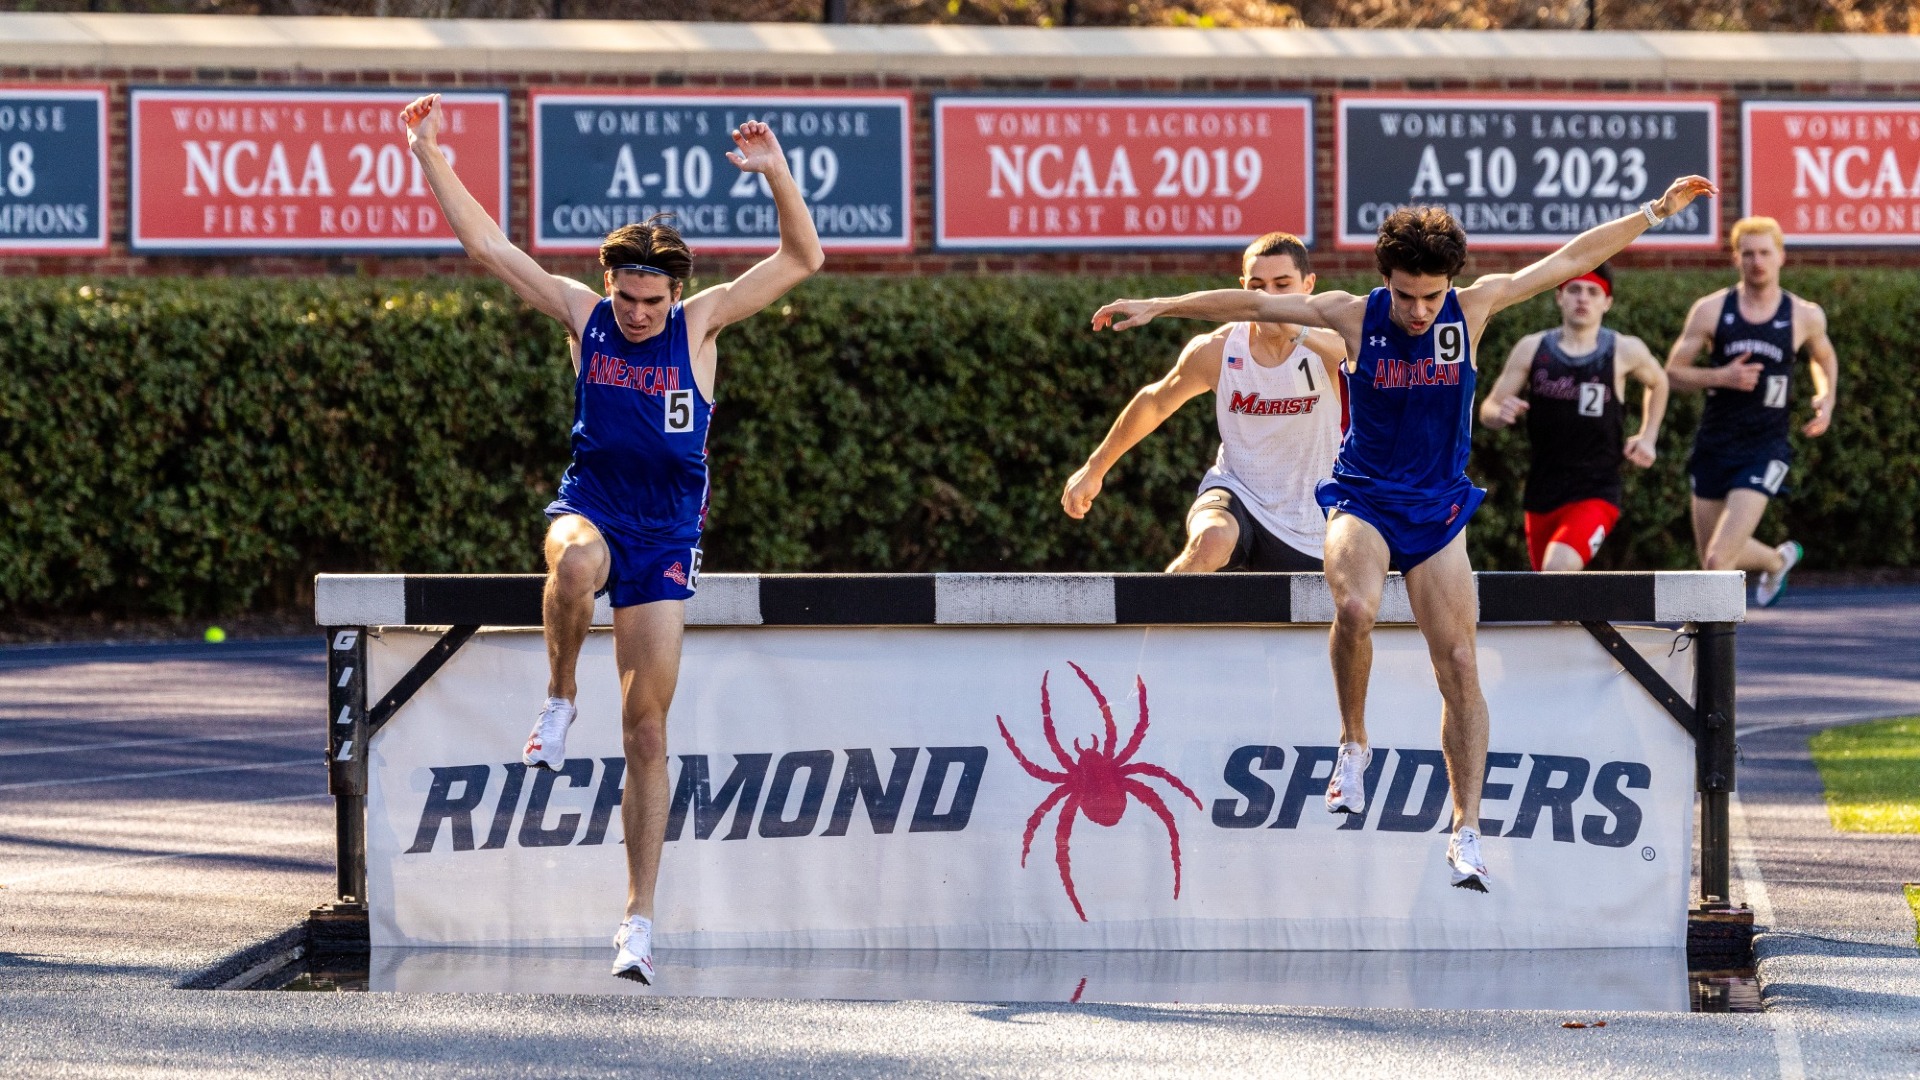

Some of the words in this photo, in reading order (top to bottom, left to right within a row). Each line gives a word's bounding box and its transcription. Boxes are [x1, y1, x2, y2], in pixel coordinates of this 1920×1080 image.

[171, 107, 307, 133] WOMEN'S
[323, 108, 467, 134] LACRE
[574, 110, 709, 136] WOMEN'S
[975, 112, 1111, 137] WOMEN'S
[1126, 112, 1272, 138] LACROSSE
[1379, 113, 1516, 138] WOMEN'S
[1532, 114, 1677, 140] LACROSSE
[1784, 115, 1920, 141] WOMEN'S
[0, 142, 35, 197] 8
[183, 140, 334, 197] NCAA
[605, 143, 713, 198] A-10
[986, 144, 1140, 199] NCAA
[1153, 146, 1262, 200] 2019
[1409, 143, 1517, 198] A-10
[1533, 146, 1648, 201] 2023
[203, 205, 299, 233] FIRST
[320, 205, 437, 233] ROUND
[735, 204, 893, 233] CHPIONS
[1008, 205, 1105, 232] FIRST
[1124, 205, 1243, 232] ROUND
[1438, 326, 1461, 361] 9
[586, 352, 680, 398] AMERICAN
[1298, 357, 1315, 391] 1
[1374, 358, 1459, 389] AMERICAN
[1229, 390, 1321, 416] MARIST
[1585, 387, 1599, 412] 2
[1772, 379, 1784, 405] 7
[668, 393, 690, 429] 5
[333, 631, 358, 761] GILL
[404, 746, 988, 854] RICHMOND
[1211, 745, 1651, 847] SPIDERS
